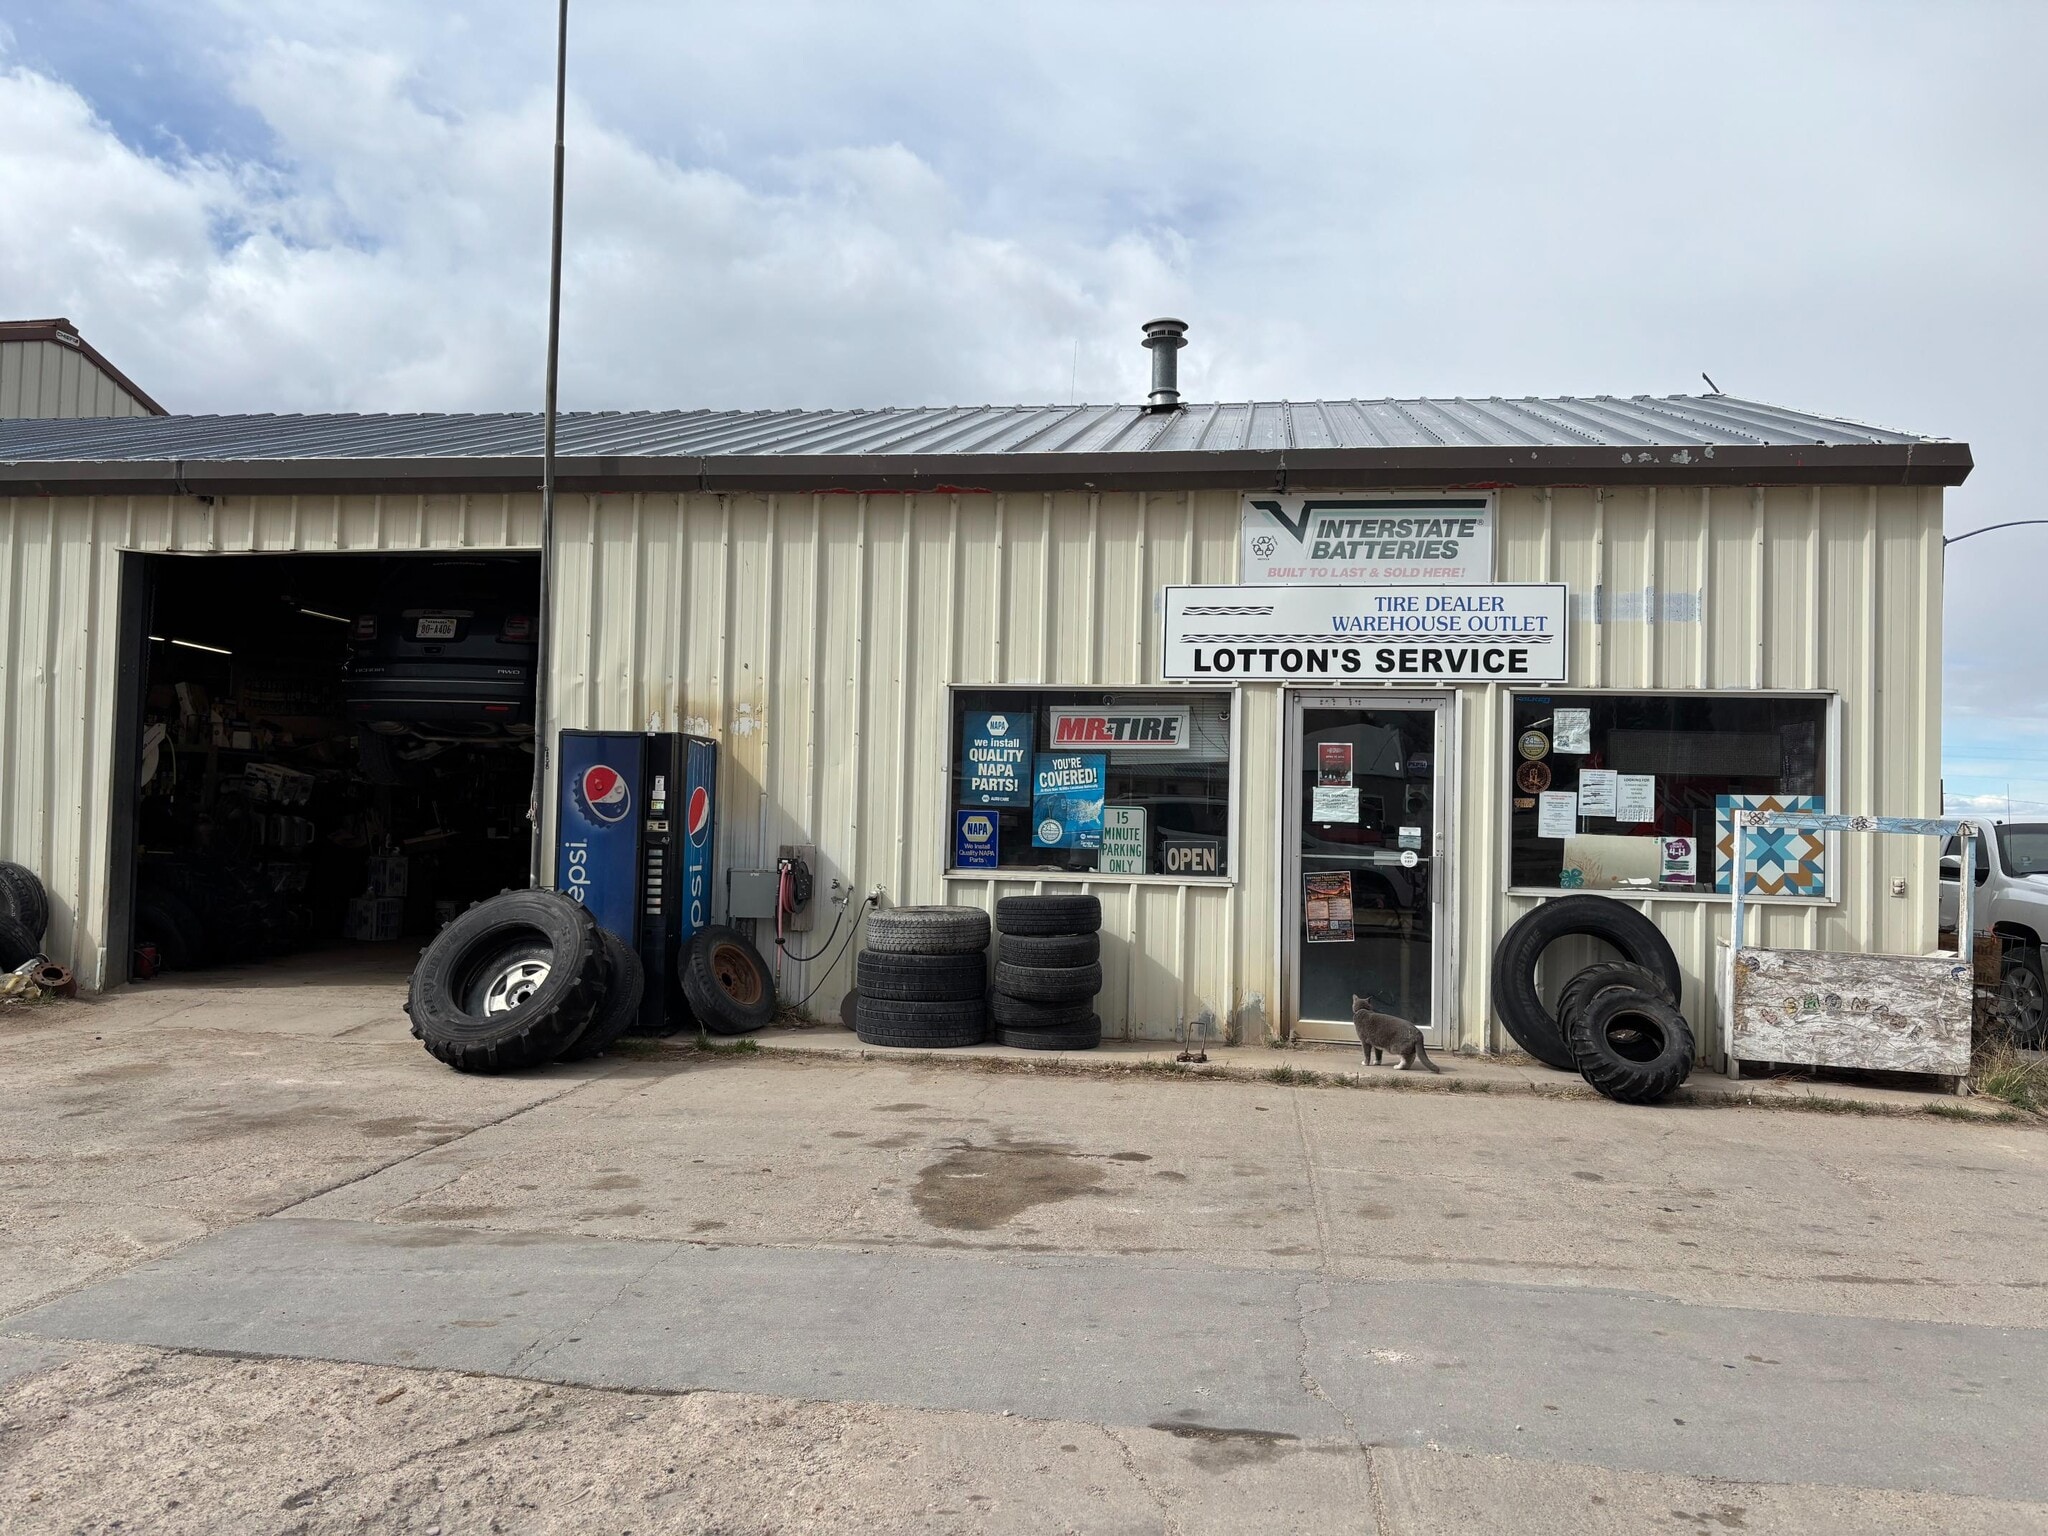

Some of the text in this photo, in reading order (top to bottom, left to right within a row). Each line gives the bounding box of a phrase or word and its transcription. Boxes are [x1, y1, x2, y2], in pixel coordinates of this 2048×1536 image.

[1317, 518, 1476, 538] INTERSTATE
[1311, 540, 1459, 560] BATTERIES
[1267, 567, 1466, 578] BUILT TO LAST & SOLD HERE!
[1375, 596, 1505, 612] TIRE DEALER
[1332, 615, 1549, 632] WAREHOUSE OUTLET
[1193, 648, 1529, 674] LOTTON'S SERVICE
[989, 720, 1006, 730] NAPA
[1115, 717, 1178, 740] TIRE
[974, 738, 1020, 748] we install
[968, 748, 1024, 763] QUALITY
[977, 763, 1014, 777] NAPA
[1052, 757, 1082, 771] YOU'RE
[971, 777, 1019, 792] PARTS!
[1039, 768, 1098, 788] COVERED!
[1116, 811, 1129, 823] 15
[967, 822, 988, 836] NAPA
[1104, 828, 1140, 841] MINUTE
[959, 849, 978, 857] Quality
[1101, 844, 1142, 857] PARKING
[1669, 848, 1686, 856] 4-H
[1109, 859, 1134, 873] ONLY
[1167, 848, 1216, 871] OPEN
[565, 841, 591, 902] epsi
